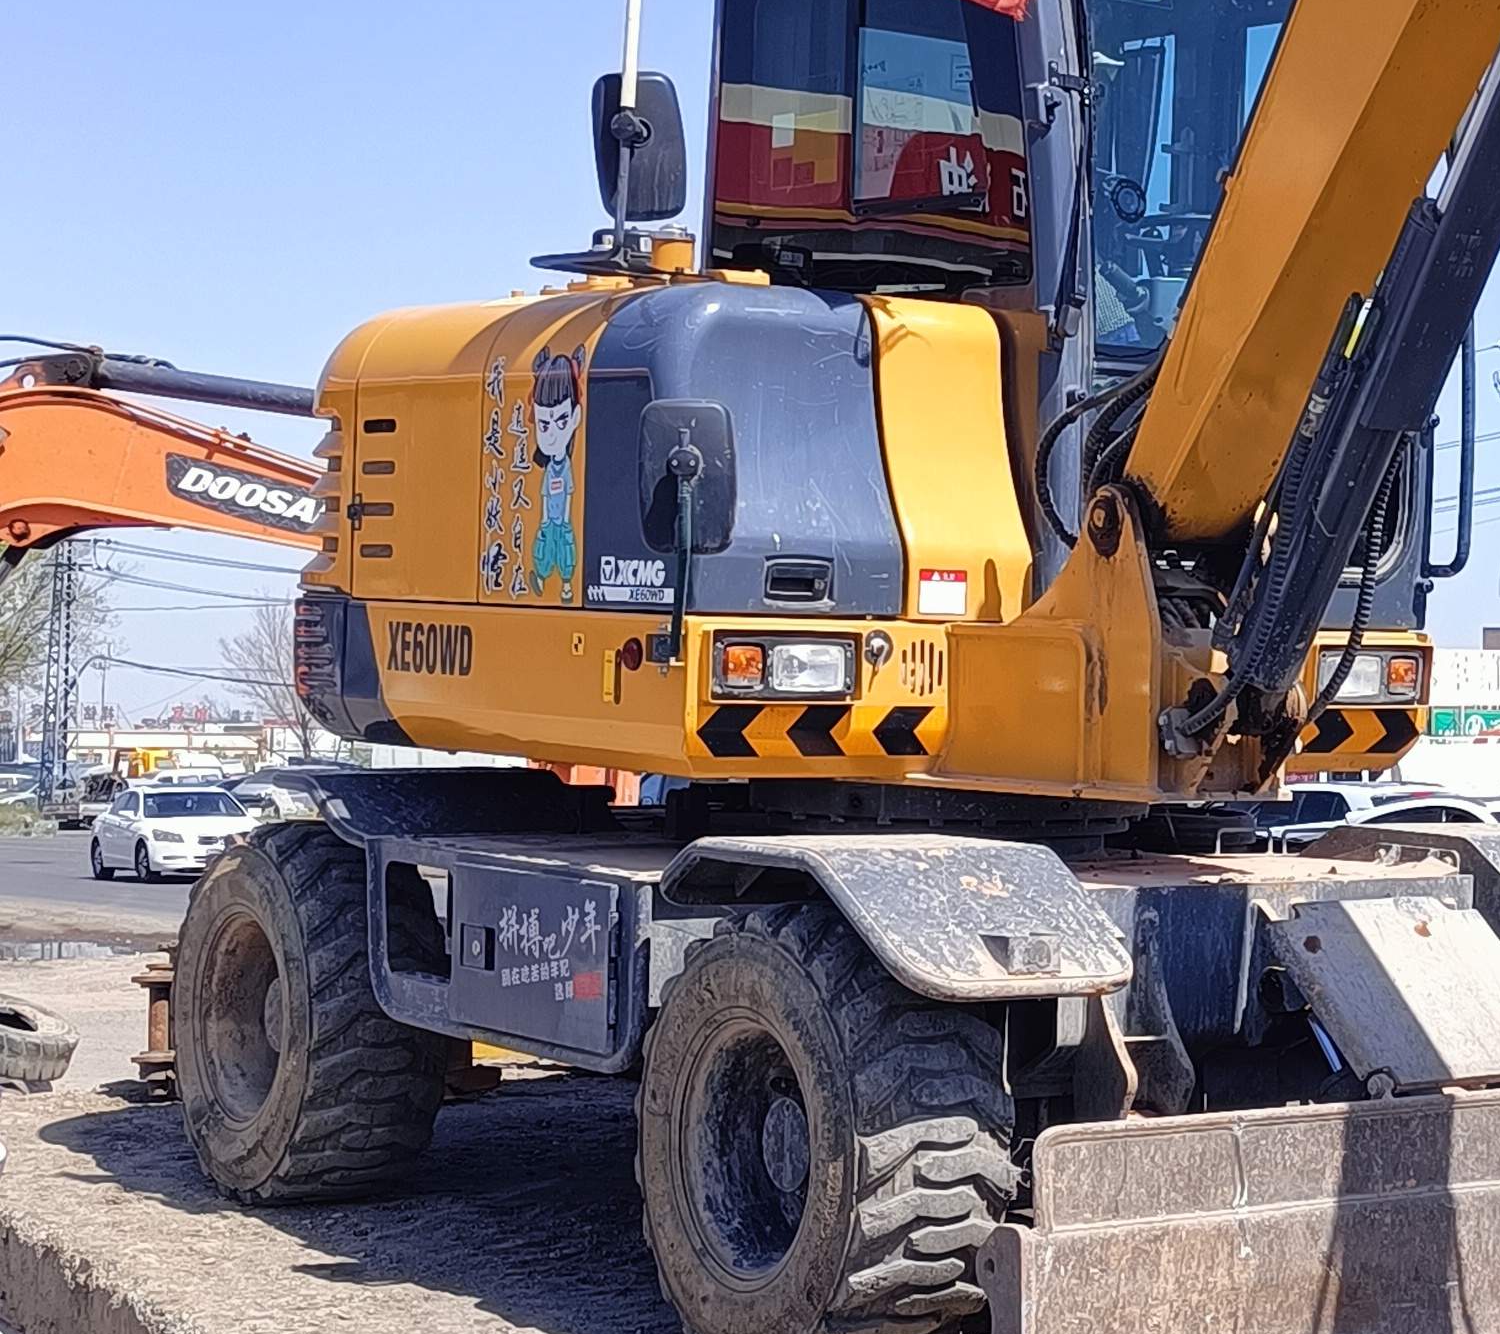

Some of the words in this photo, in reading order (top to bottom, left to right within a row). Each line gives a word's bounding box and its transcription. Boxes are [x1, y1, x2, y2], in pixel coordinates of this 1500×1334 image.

[177, 466, 326, 524] DOOSA
[481, 357, 509, 596] 我是小妖怪
[615, 559, 666, 586] XCMG
[628, 587, 665, 602] XE60WD
[387, 621, 473, 677] XE60WD
[499, 898, 601, 959] 拼搏吧少年
